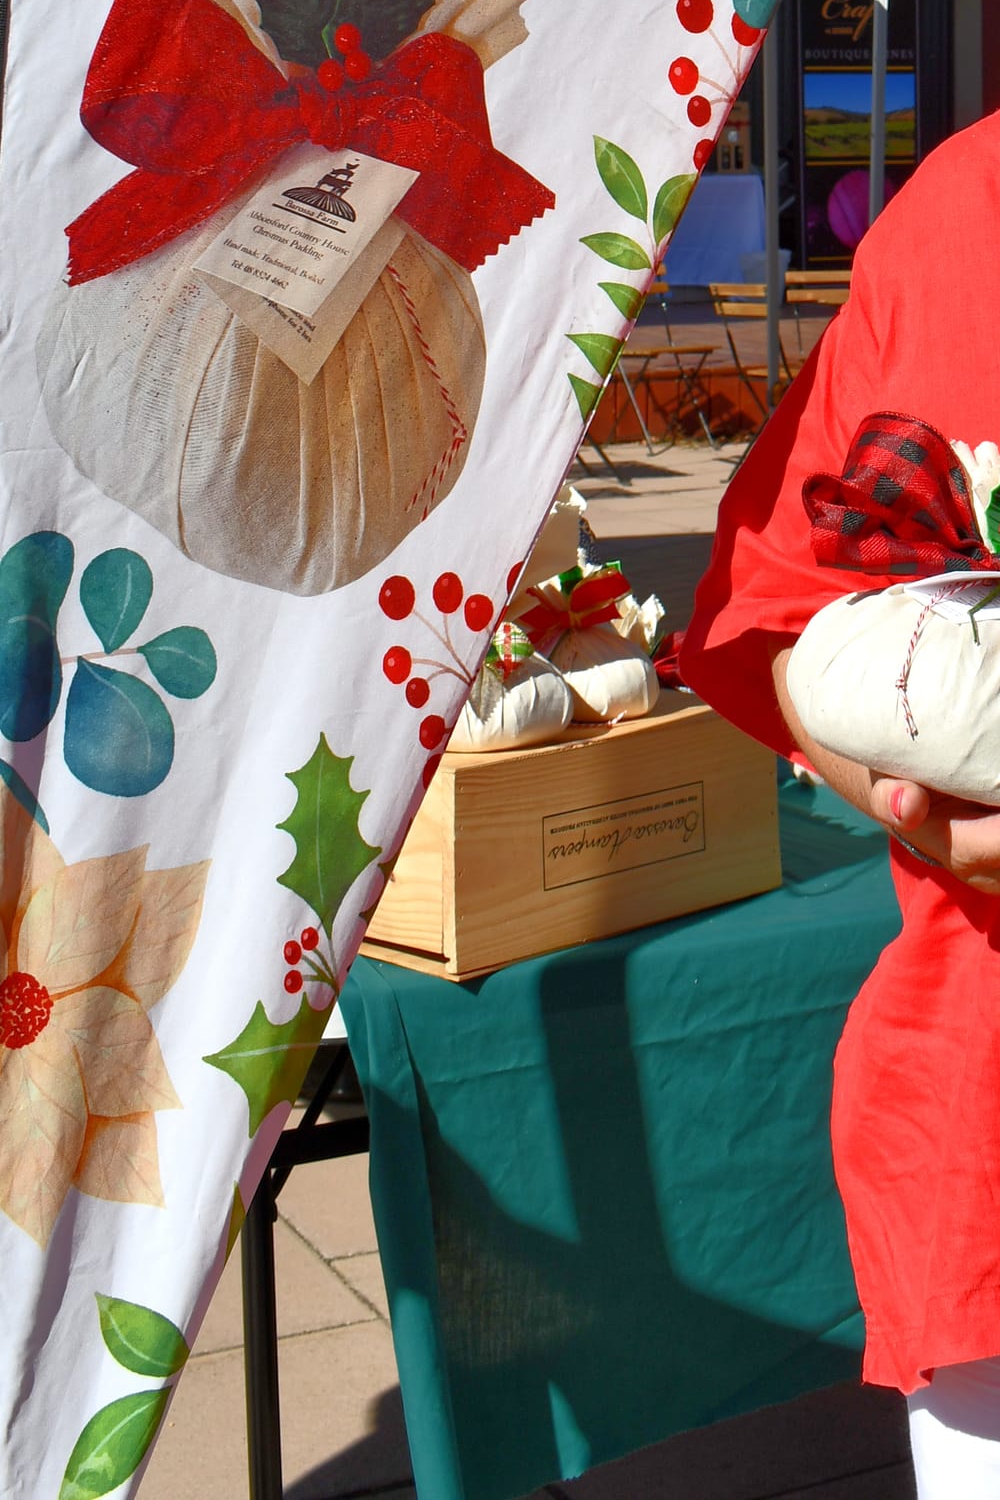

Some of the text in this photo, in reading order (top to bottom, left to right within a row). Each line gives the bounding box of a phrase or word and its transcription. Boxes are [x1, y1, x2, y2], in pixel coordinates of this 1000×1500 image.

[804, 48, 870, 61] BOUTIQUE
[284, 200, 339, 227] Barossa Farm
[253, 225, 324, 261] Christmas Pudding
[289, 225, 320, 246] Country
[321, 238, 350, 256] House
[548, 810, 699, 862] Barossa Hampers
